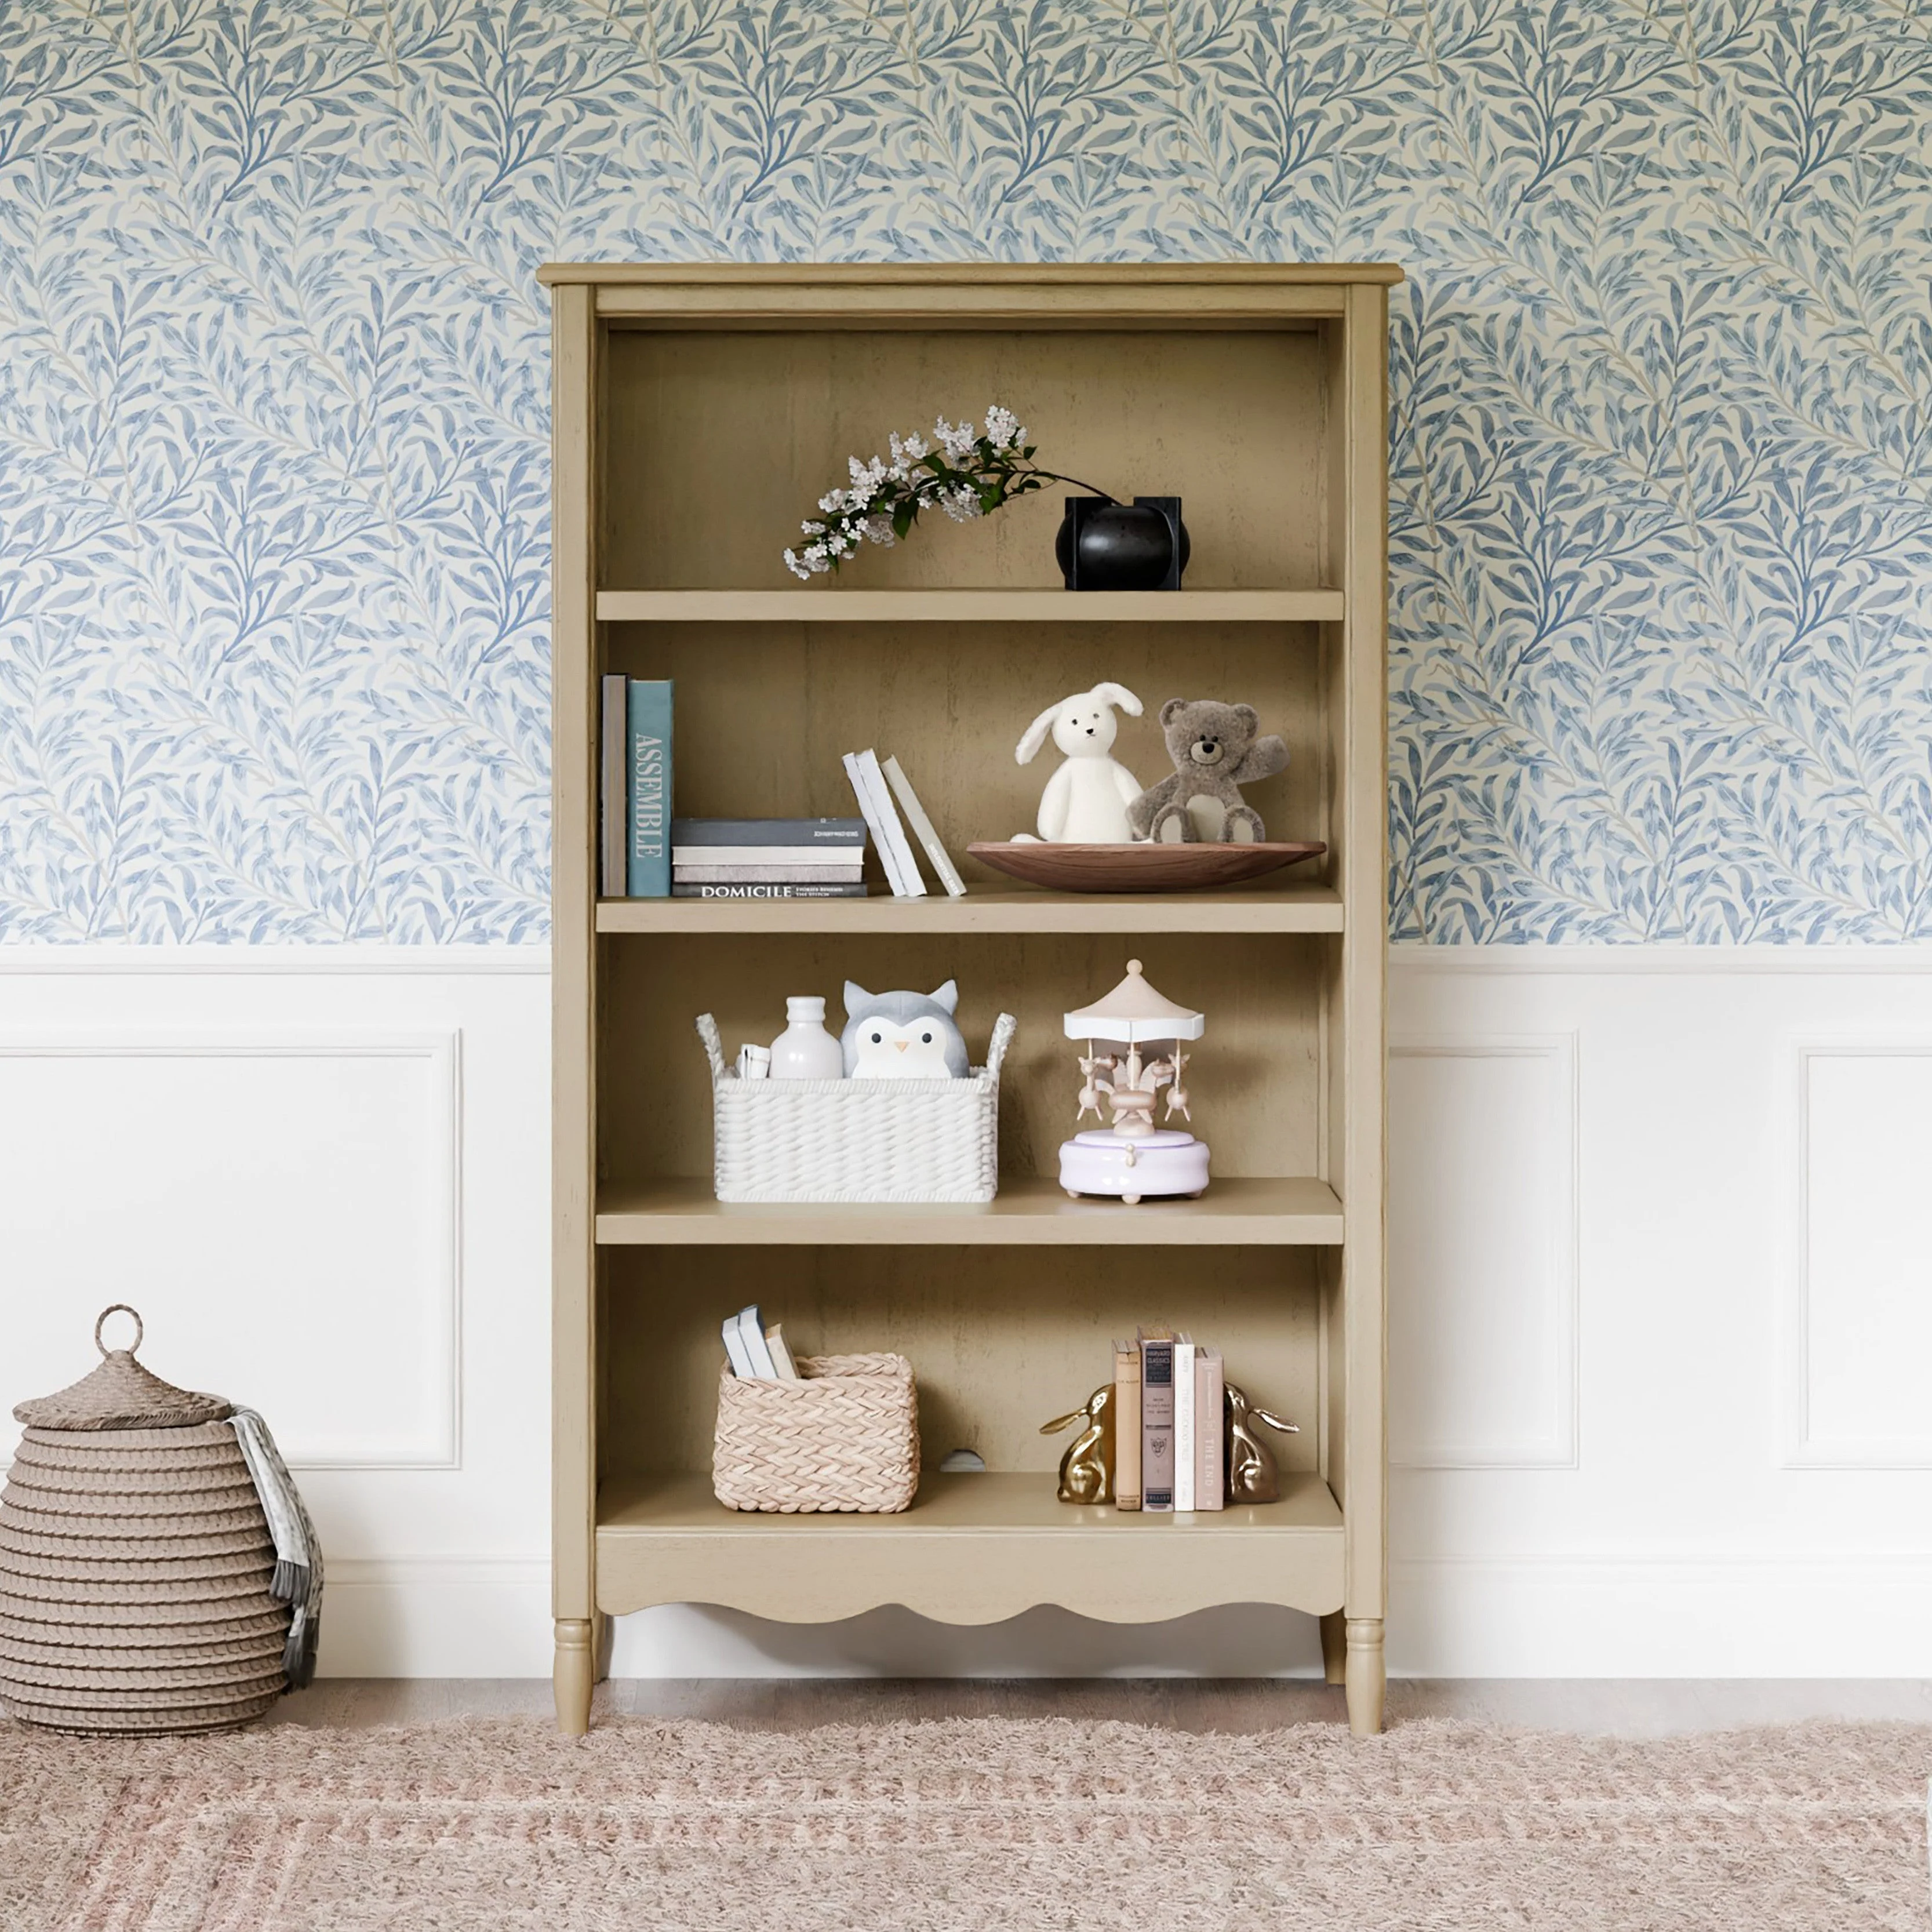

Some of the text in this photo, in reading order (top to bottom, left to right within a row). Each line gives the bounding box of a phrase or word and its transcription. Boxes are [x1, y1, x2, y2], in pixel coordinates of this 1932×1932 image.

[636, 733, 662, 858] ASSEMBLE
[701, 886, 791, 897] DOMICILE
[1205, 1438, 1214, 1486] THE END
